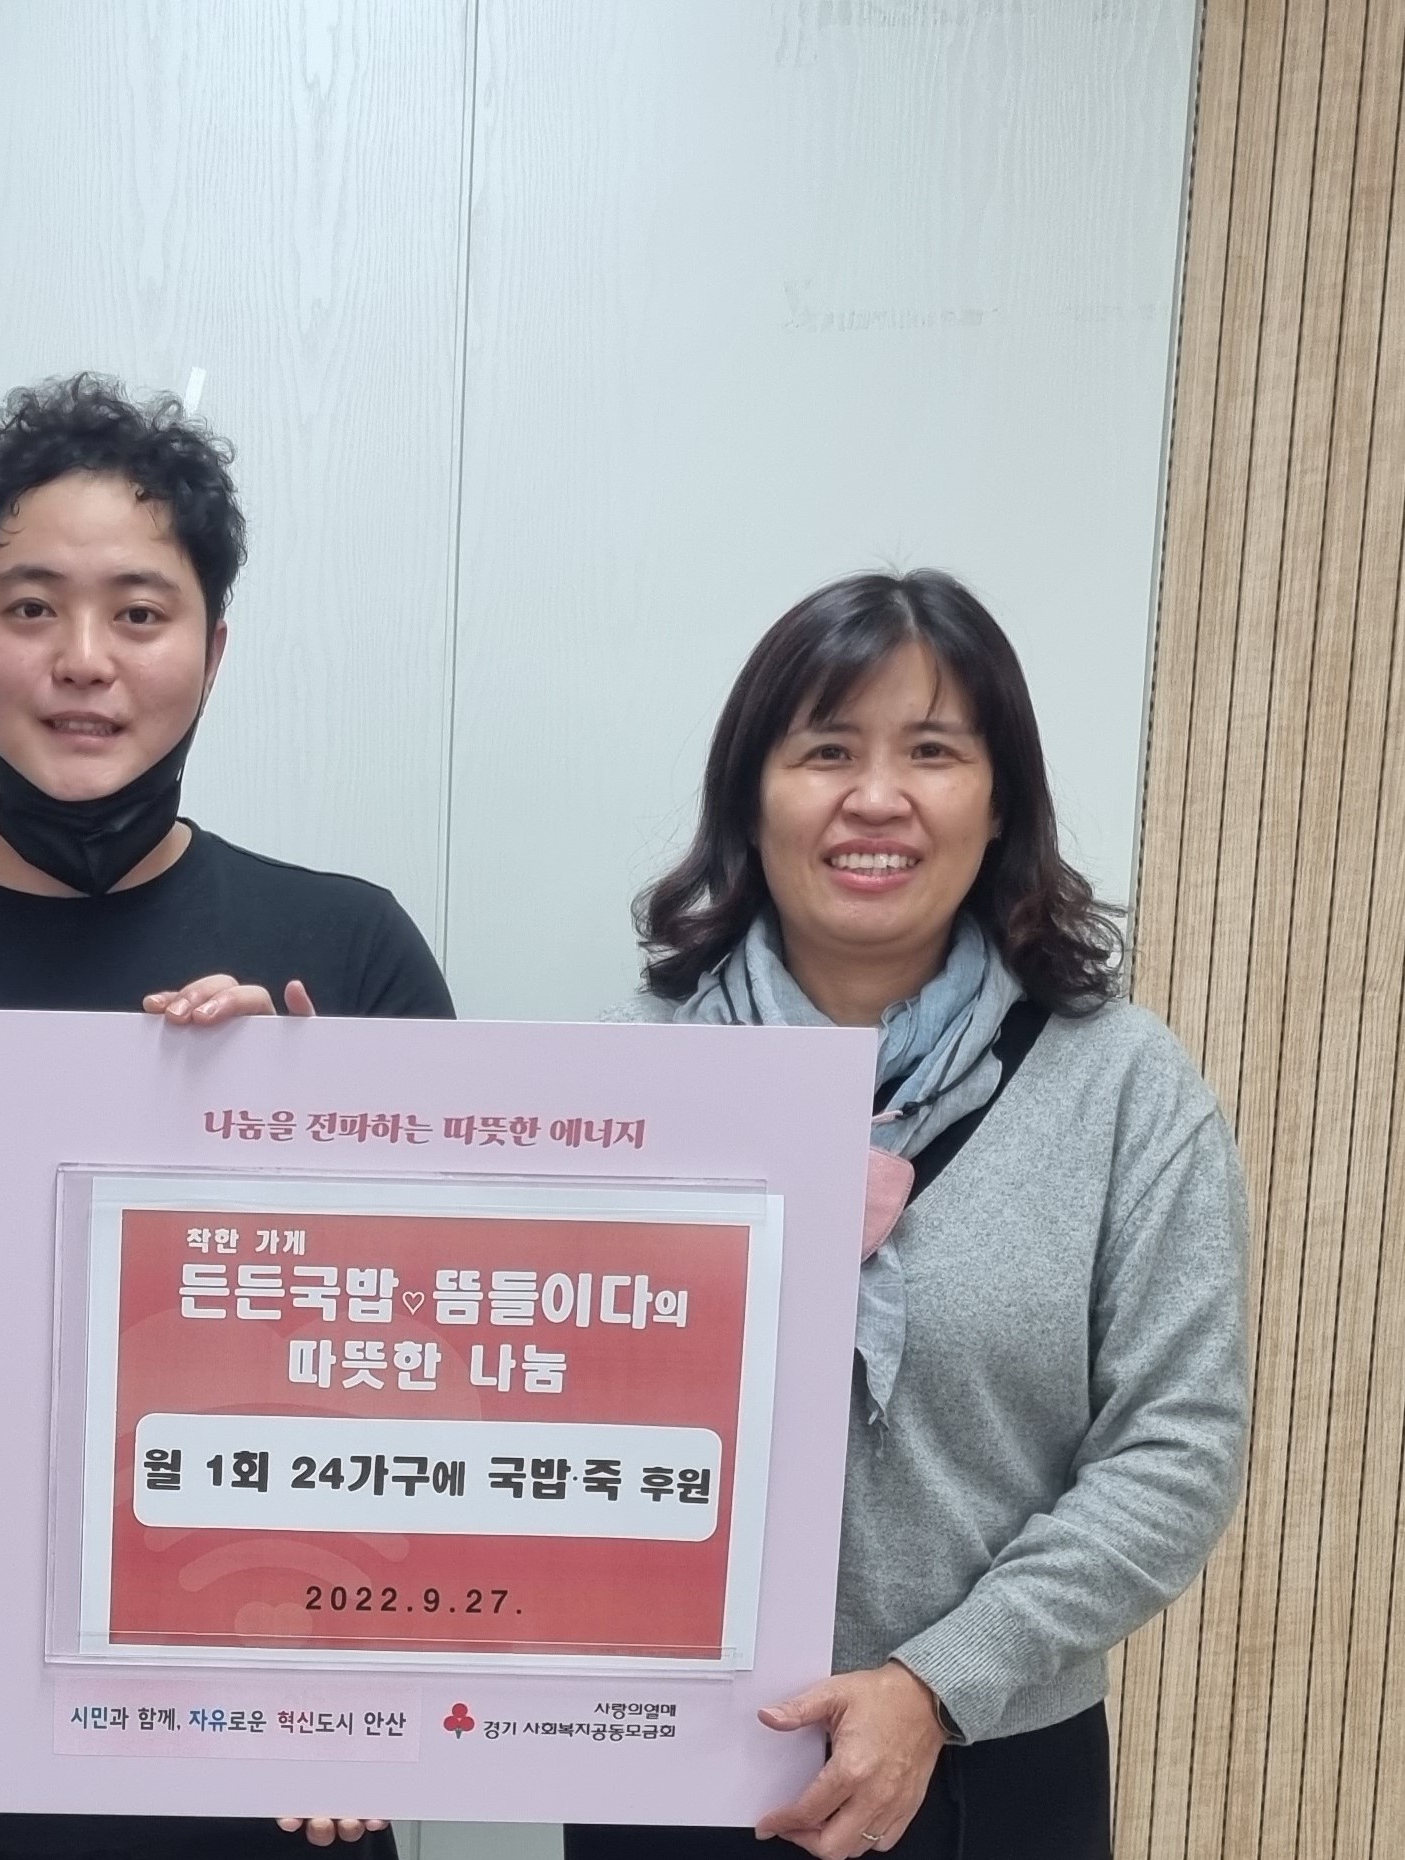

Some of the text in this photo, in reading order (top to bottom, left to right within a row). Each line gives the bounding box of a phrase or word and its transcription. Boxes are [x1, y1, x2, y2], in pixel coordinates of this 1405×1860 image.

[204, 1110, 646, 1150] 나눔을 전파하는 따뜻한 에너지
[186, 1228, 307, 1256] 착한 가게
[179, 1263, 689, 1330] 든든국밥 뜸들이다의
[288, 1340, 567, 1393] 따뜻한 나눔
[144, 1449, 181, 1490] 월
[205, 1450, 269, 1492] 1회
[291, 1455, 466, 1497] 24가구에
[640, 1466, 711, 1505] 후원
[305, 1586, 524, 1616] 2022.9.27.
[70, 1706, 407, 1737] 시민과 함께, 자유로운 혁신도시 안산
[593, 1702, 677, 1720] 사랑의열매
[483, 1720, 676, 1742] 경기 사회복지공동모금회
